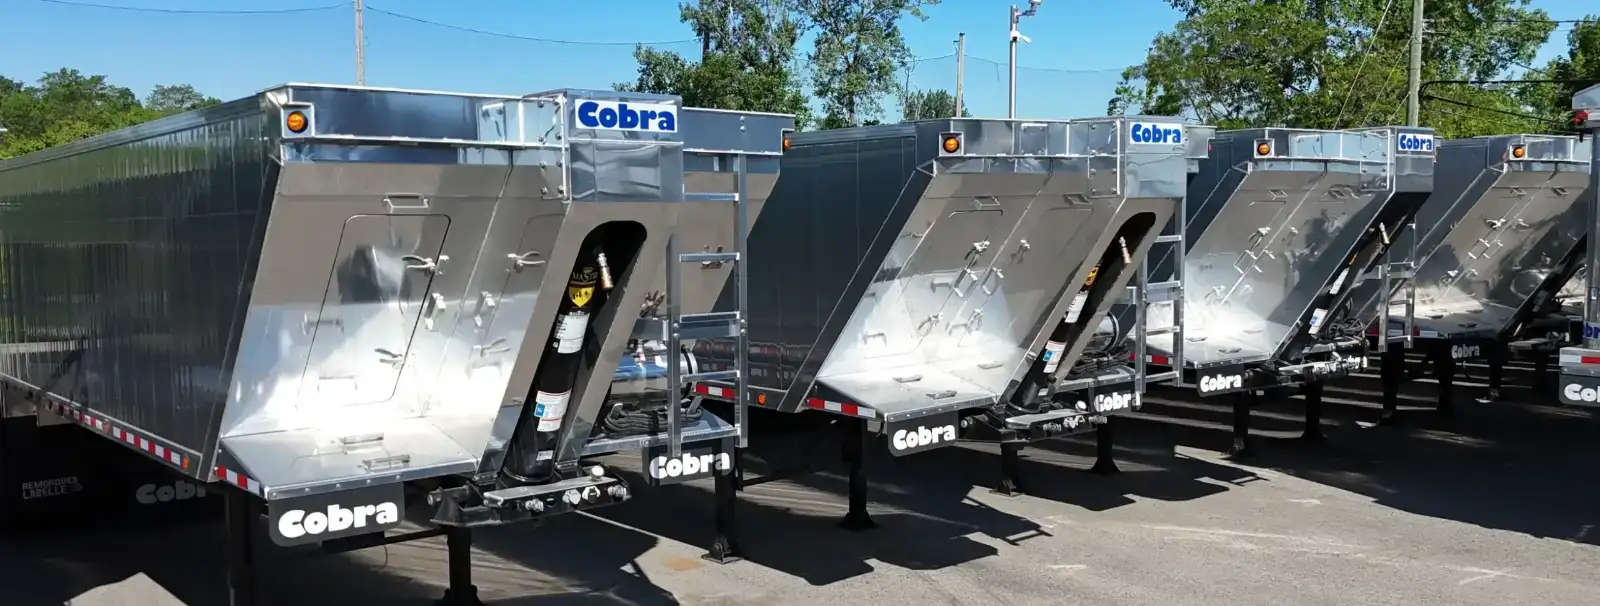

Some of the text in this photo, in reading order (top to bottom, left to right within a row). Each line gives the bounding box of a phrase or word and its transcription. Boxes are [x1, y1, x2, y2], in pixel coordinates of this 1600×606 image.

[578, 101, 675, 131] Cobra
[1131, 123, 1181, 143] Cobra
[1400, 134, 1432, 150] Cobra
[1451, 343, 1480, 359] Cobra
[1200, 374, 1242, 392] Cobra
[1564, 383, 1600, 402] Co
[1093, 391, 1140, 412] Cobra
[893, 424, 956, 450] Cobra
[649, 452, 730, 479] Cobra
[278, 501, 398, 538] Cobra
